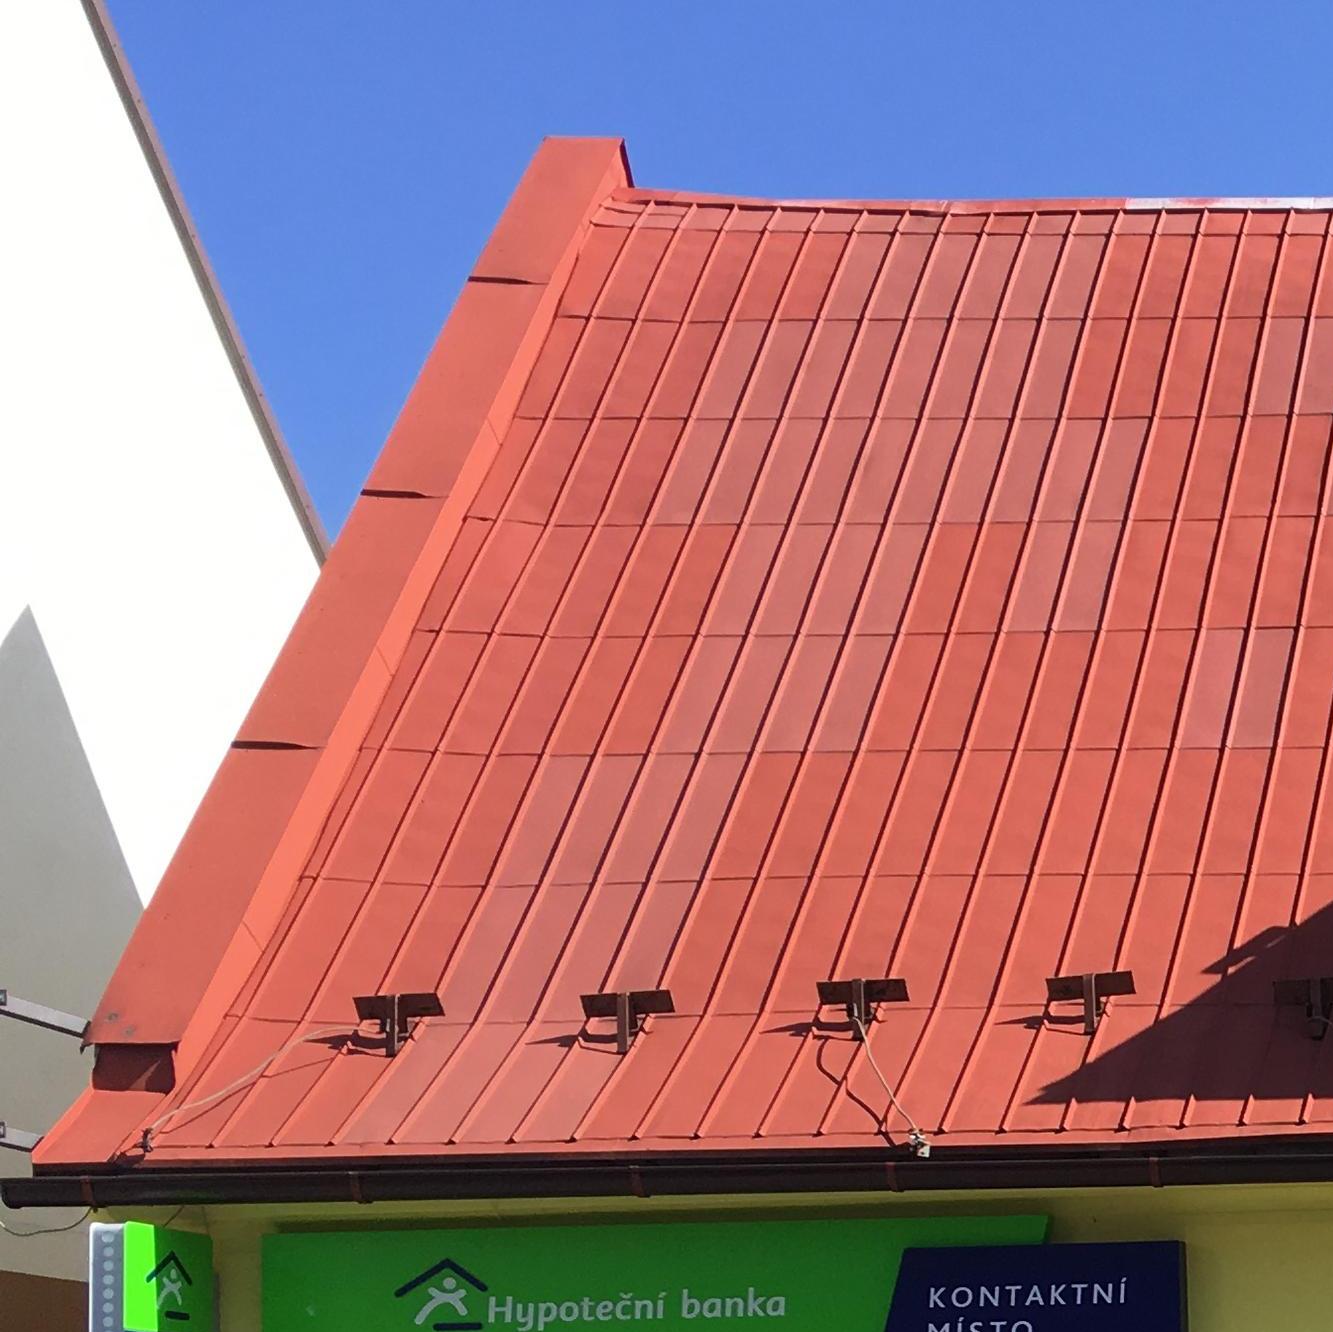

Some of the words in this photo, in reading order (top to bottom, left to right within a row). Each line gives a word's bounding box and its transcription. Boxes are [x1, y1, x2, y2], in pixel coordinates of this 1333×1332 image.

[487, 1292, 667, 1332] Hypoteční
[681, 1287, 786, 1319] banka
[928, 1277, 1129, 1309] KONTAKTNÍ
